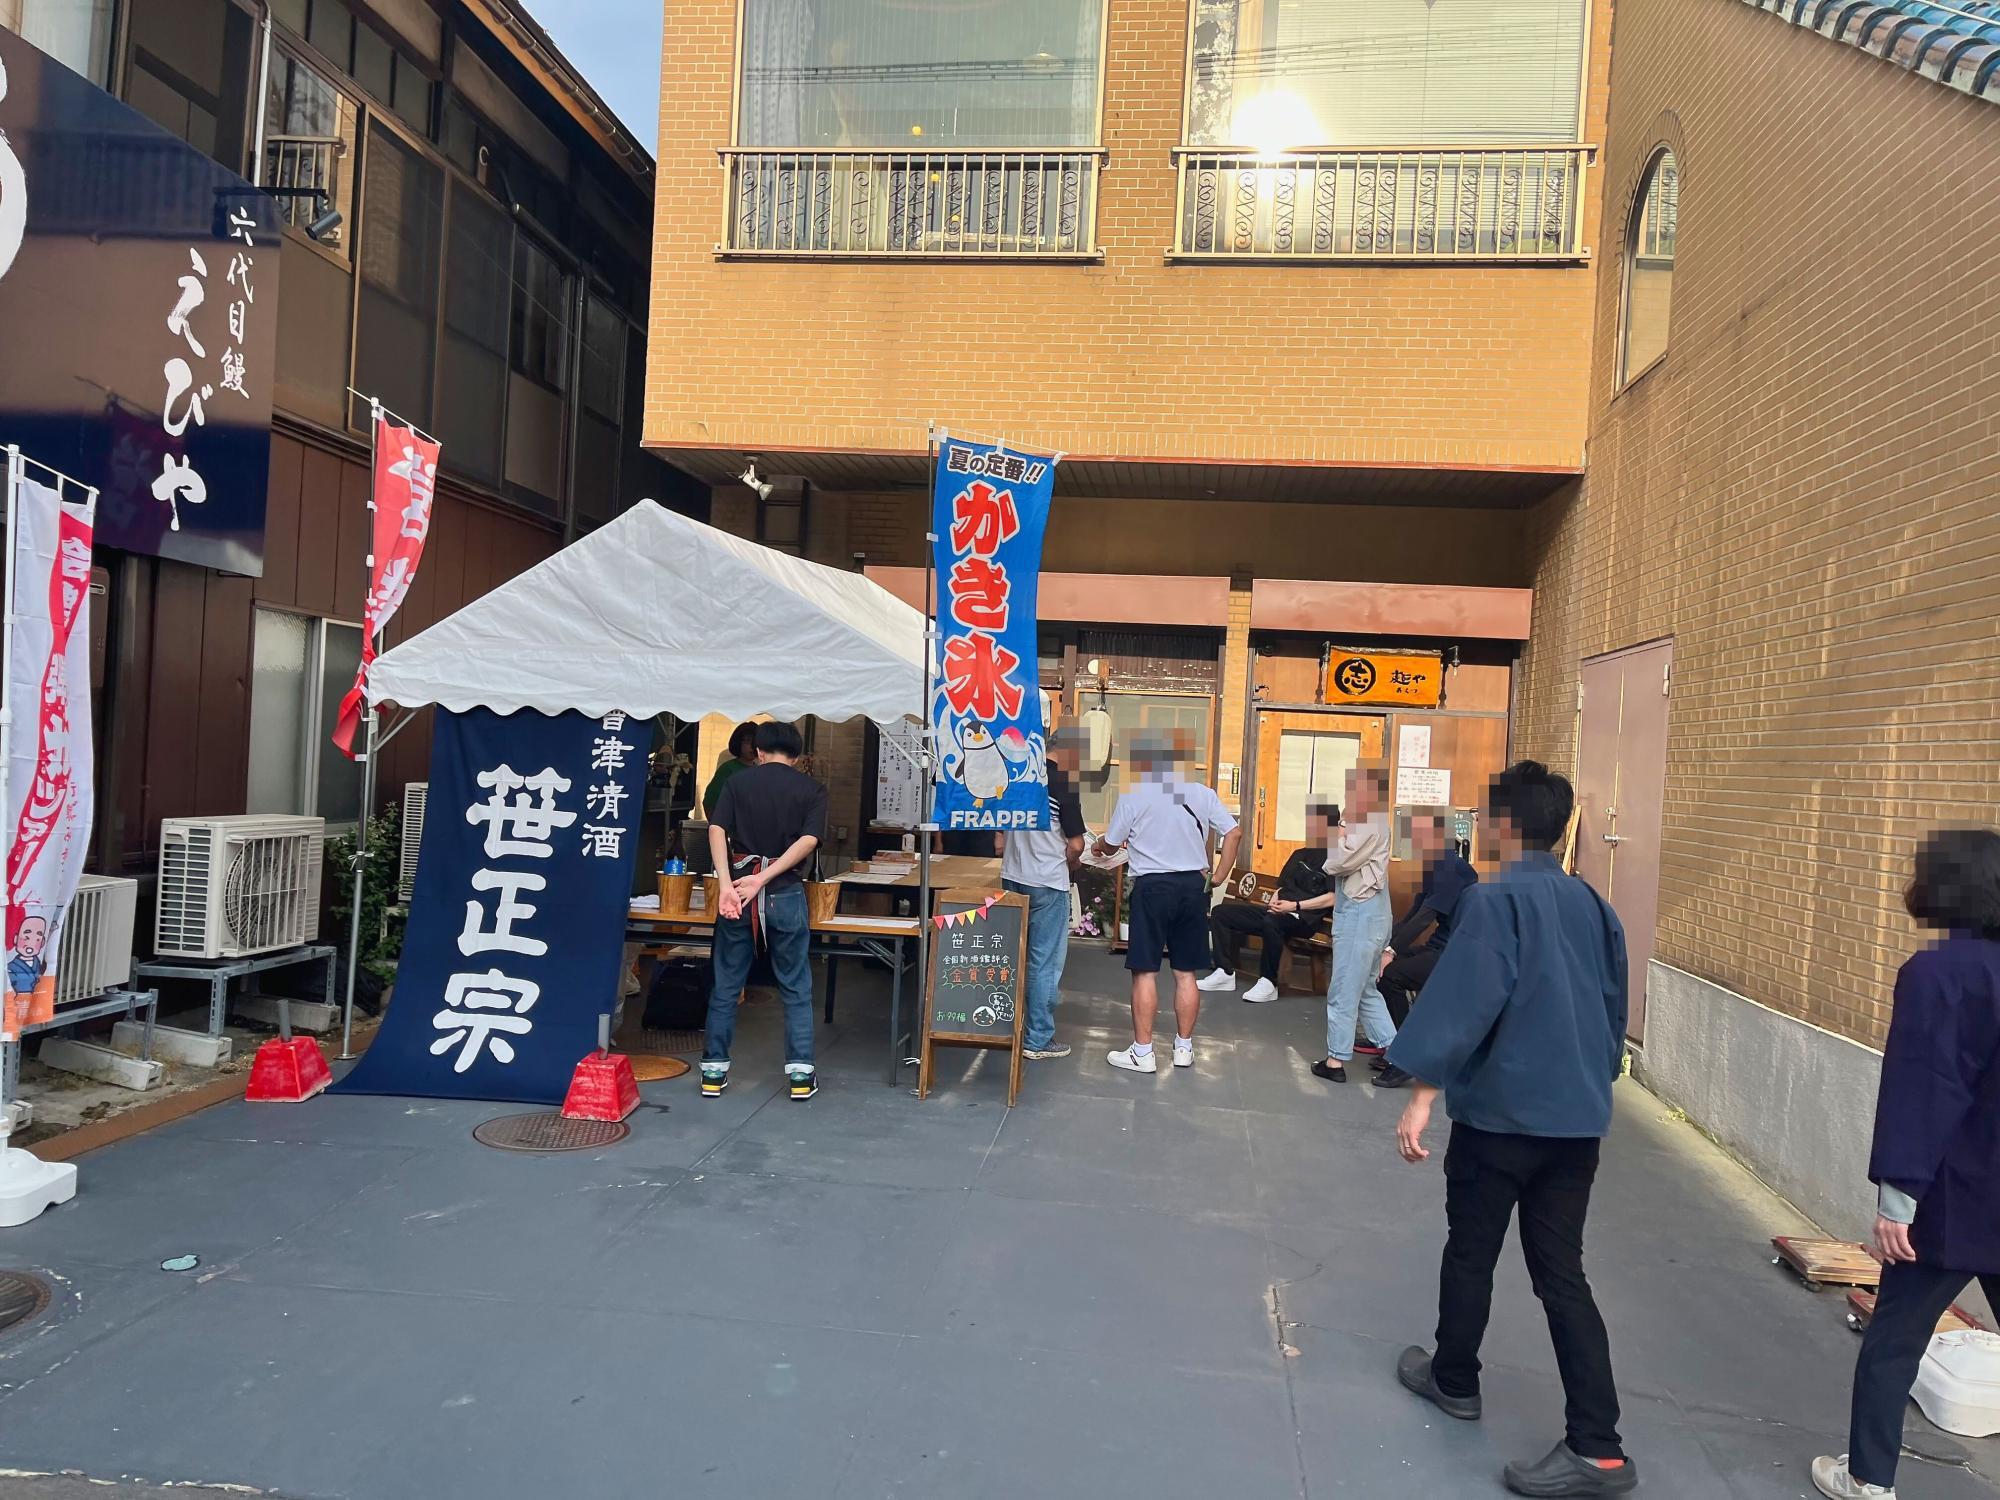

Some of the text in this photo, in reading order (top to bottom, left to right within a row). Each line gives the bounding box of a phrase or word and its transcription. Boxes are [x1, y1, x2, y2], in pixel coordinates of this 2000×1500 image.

[152, 247, 213, 531] えびや
[221, 206, 256, 400] 六代目鰻
[945, 480, 1024, 721] かき氷
[430, 764, 577, 1072] 笹正宗
[951, 810, 1038, 828] FRAPPE
[952, 933, 1003, 948] 笹正宗
